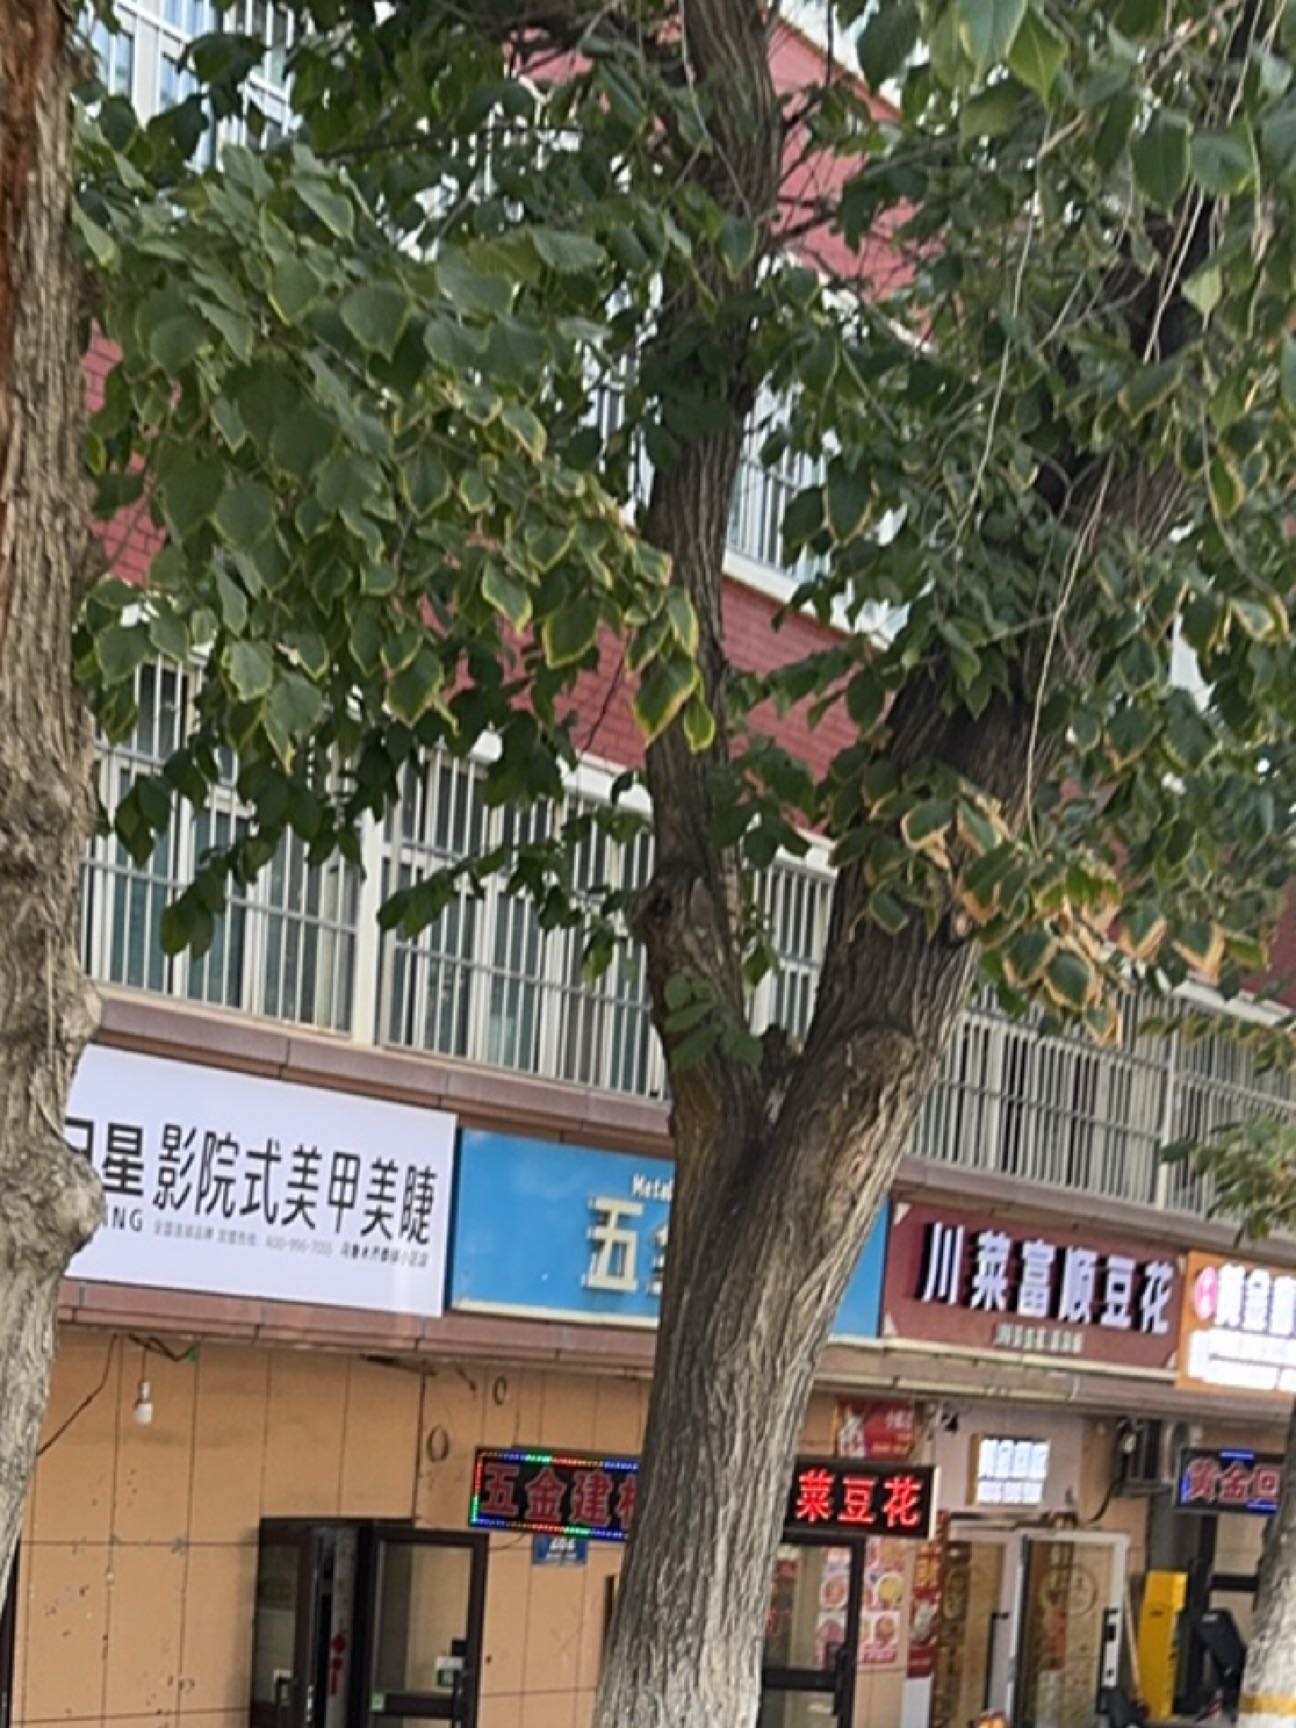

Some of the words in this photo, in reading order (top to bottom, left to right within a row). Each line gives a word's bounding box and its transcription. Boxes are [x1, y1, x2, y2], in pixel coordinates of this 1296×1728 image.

[583, 1196, 668, 1295] 五
[921, 1221, 1174, 1334] 川菜富顺豆花
[796, 1468, 923, 1528] 菜豆花
